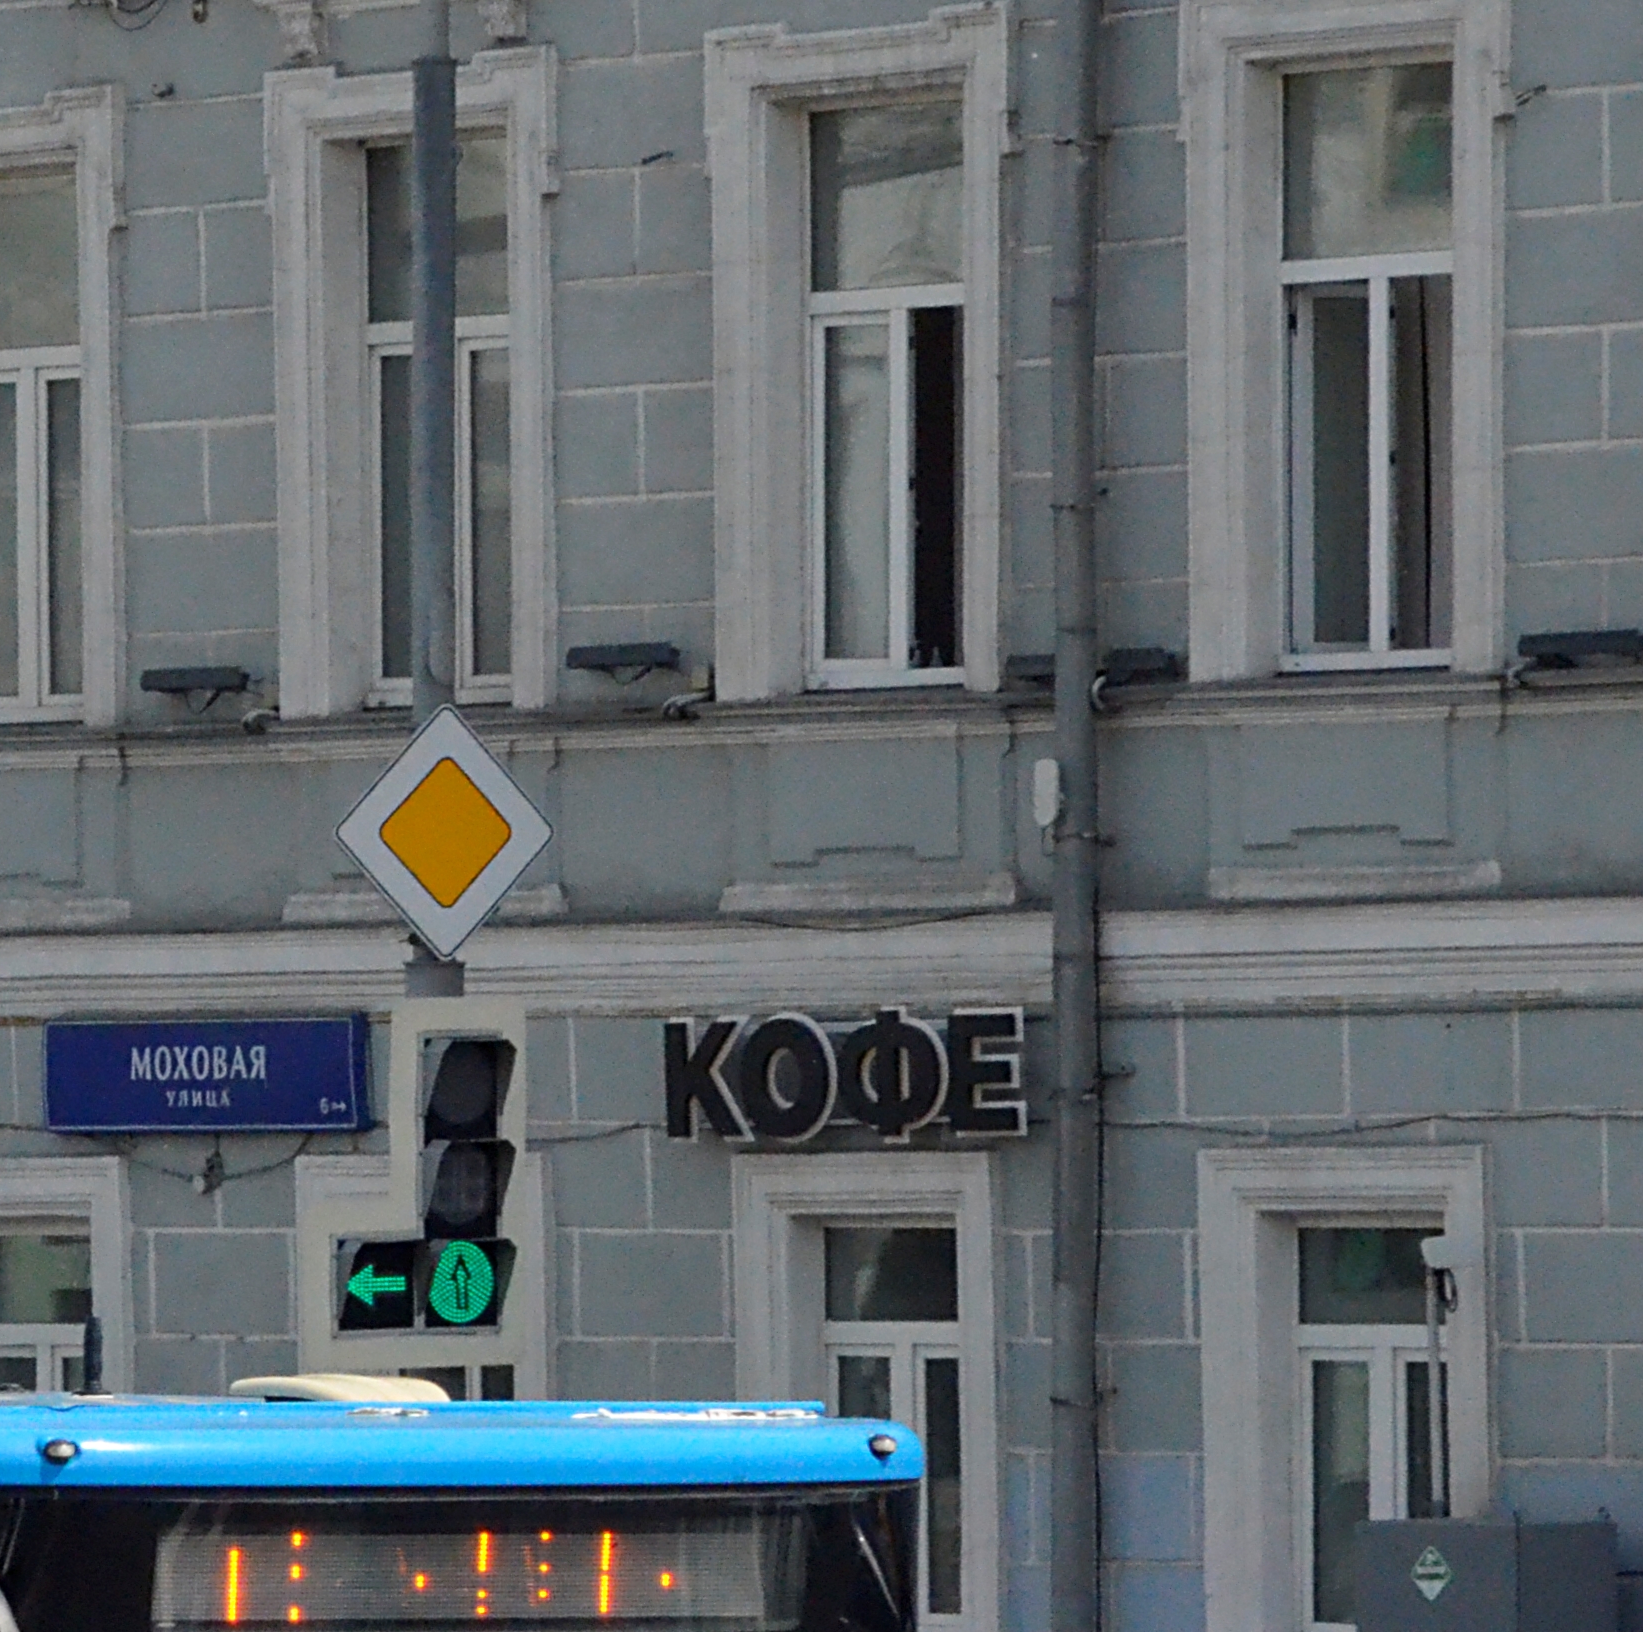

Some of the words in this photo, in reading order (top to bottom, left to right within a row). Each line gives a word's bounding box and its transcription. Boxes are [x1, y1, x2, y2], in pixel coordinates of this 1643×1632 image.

[130, 1045, 266, 1081] МОХОВАЯ
[664, 1006, 1028, 1144] КОФЕ
[165, 1088, 232, 1108] УЛИЦА
[319, 1096, 329, 1115] 6
